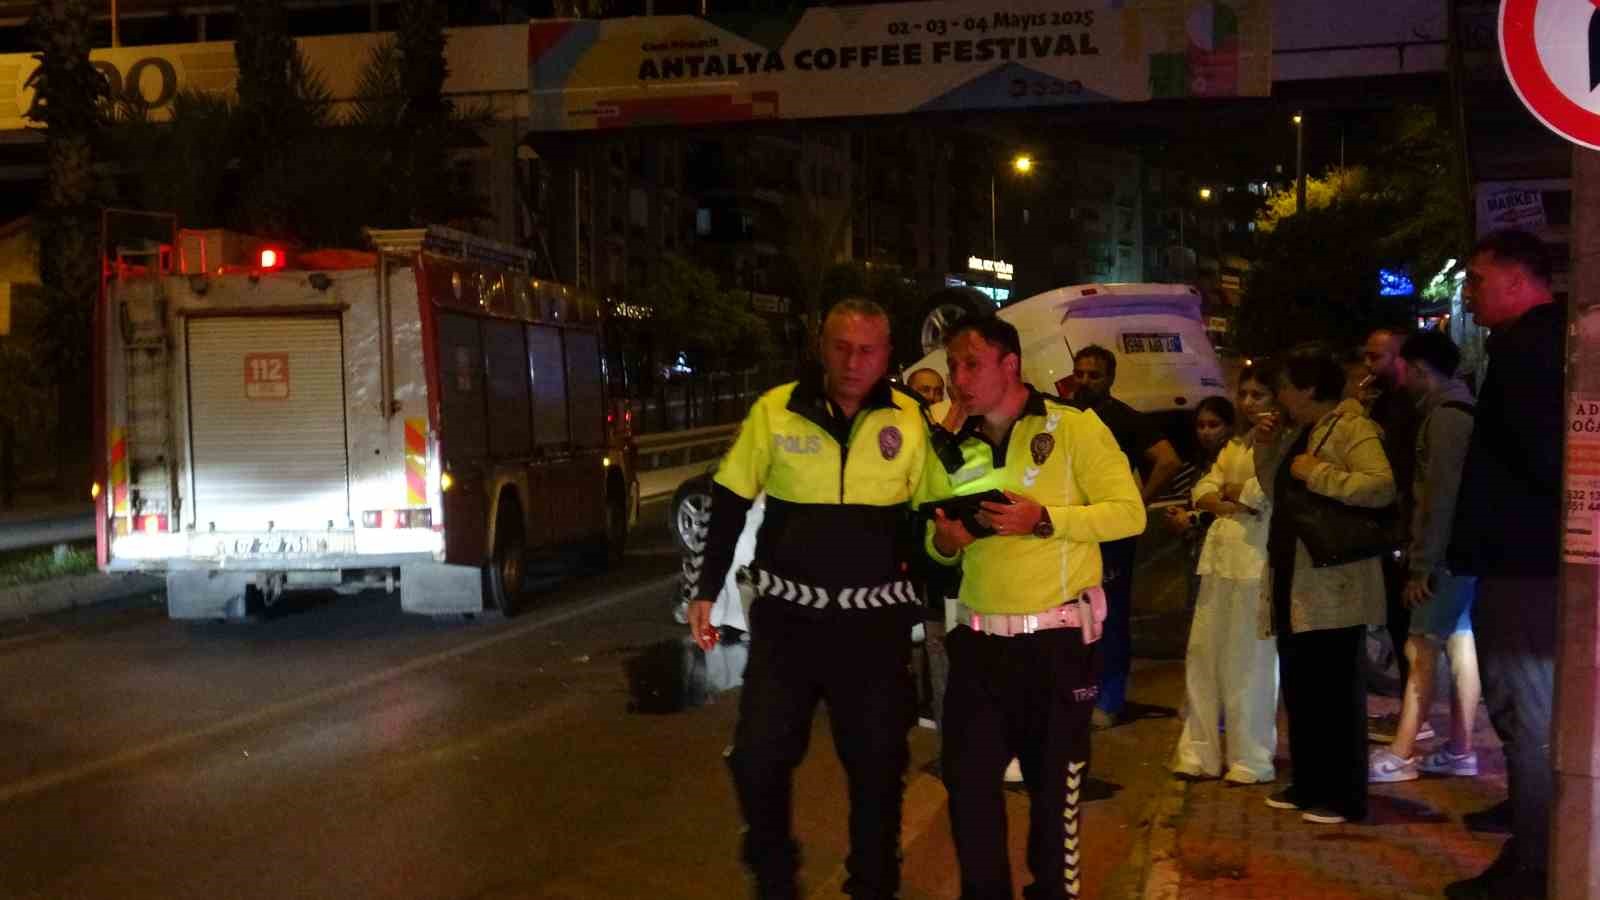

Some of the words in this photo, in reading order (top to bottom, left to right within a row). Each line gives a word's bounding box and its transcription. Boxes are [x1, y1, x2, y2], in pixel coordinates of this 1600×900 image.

[888, 21, 910, 35] 02
[926, 19, 947, 36] 03
[964, 16, 988, 33] 04
[1051, 10, 1094, 27] 2025
[639, 50, 785, 80] ANTALYA
[795, 41, 922, 72] COFFEE
[933, 33, 1099, 64] FESTIVAL
[249, 358, 283, 381] 112
